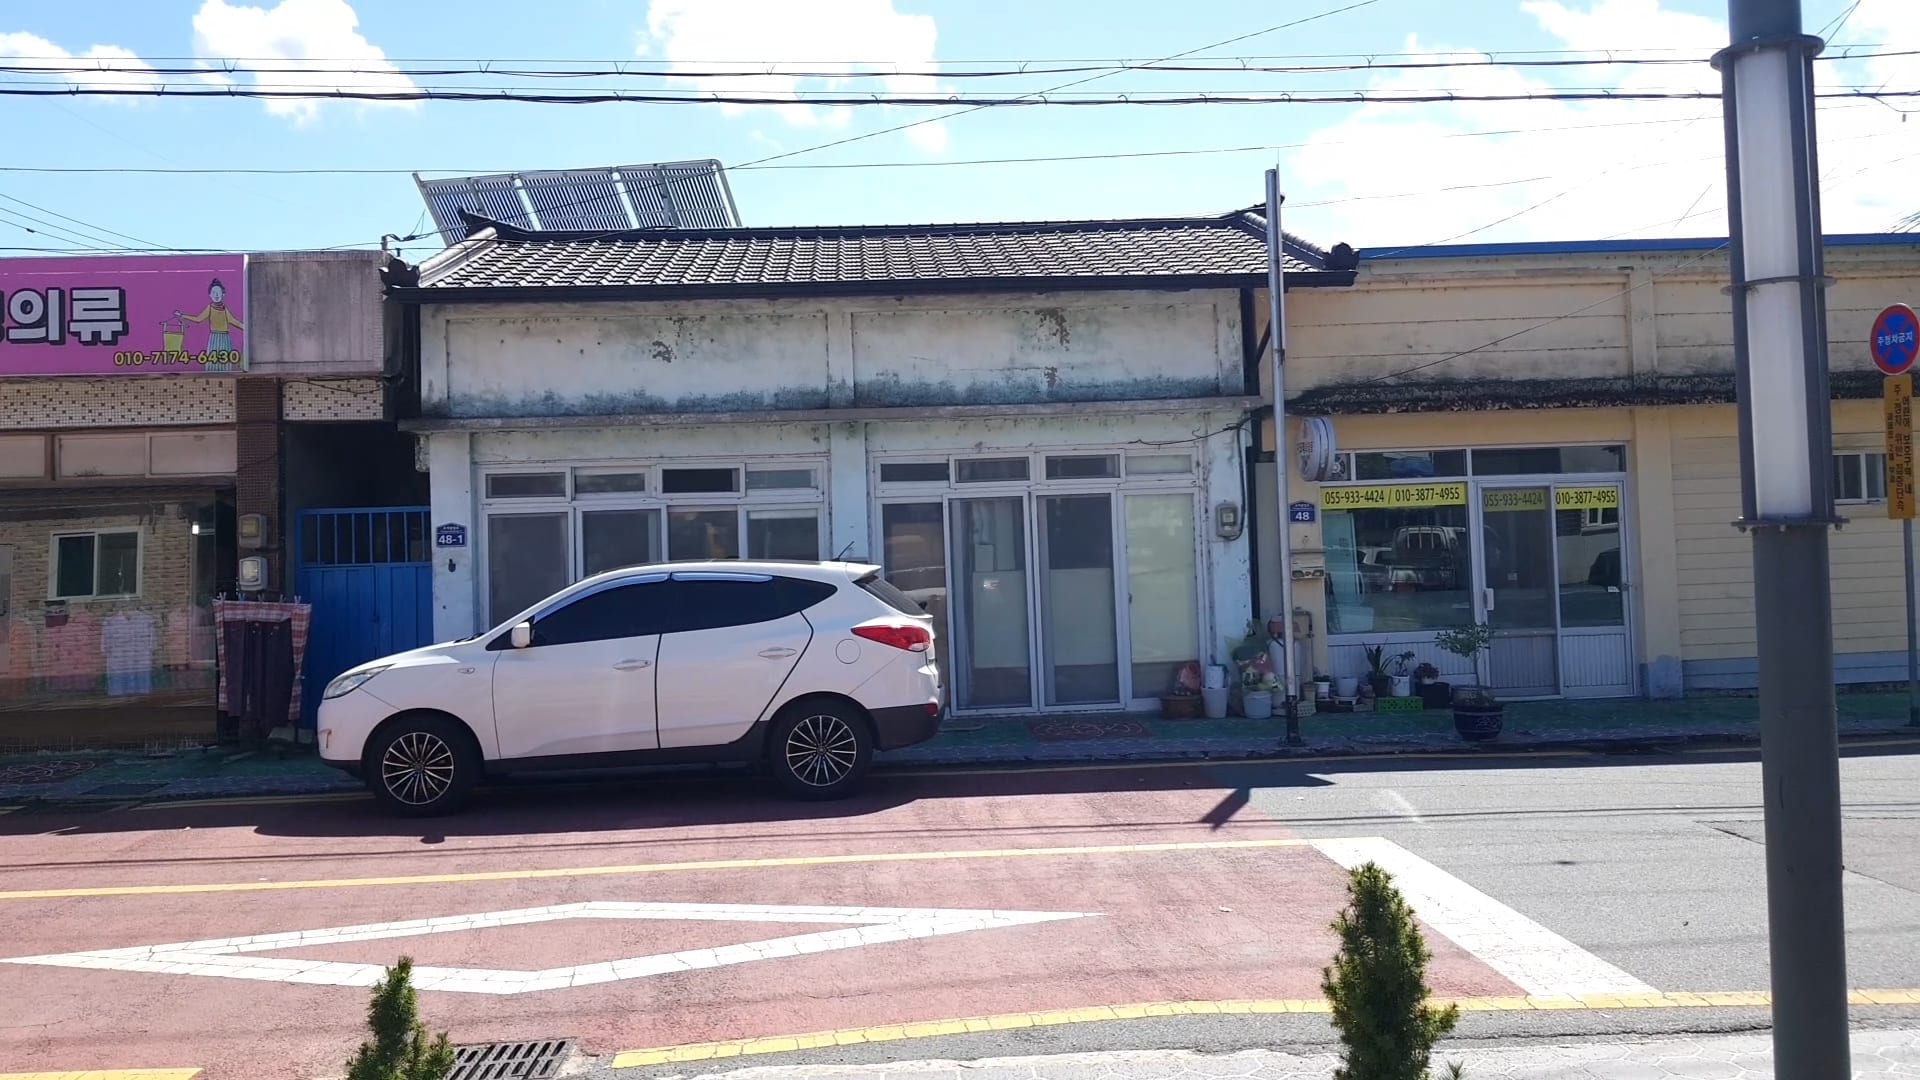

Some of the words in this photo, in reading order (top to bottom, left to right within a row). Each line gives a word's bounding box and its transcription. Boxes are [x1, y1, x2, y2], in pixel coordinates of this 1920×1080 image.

[0, 287, 126, 343] 의류
[1877, 331, 1913, 346] 주정차금지
[113, 350, 241, 366] 010-7174-6430
[1324, 490, 1384, 505] 055-933-4424
[1387, 488, 1392, 504] /
[1394, 487, 1460, 502] 010-3877-4955
[1483, 491, 1543, 507] 055-933-4424
[1555, 490, 1616, 505] 010-3877-4955
[1295, 511, 1310, 521] 48
[438, 534, 464, 545] 48-1
